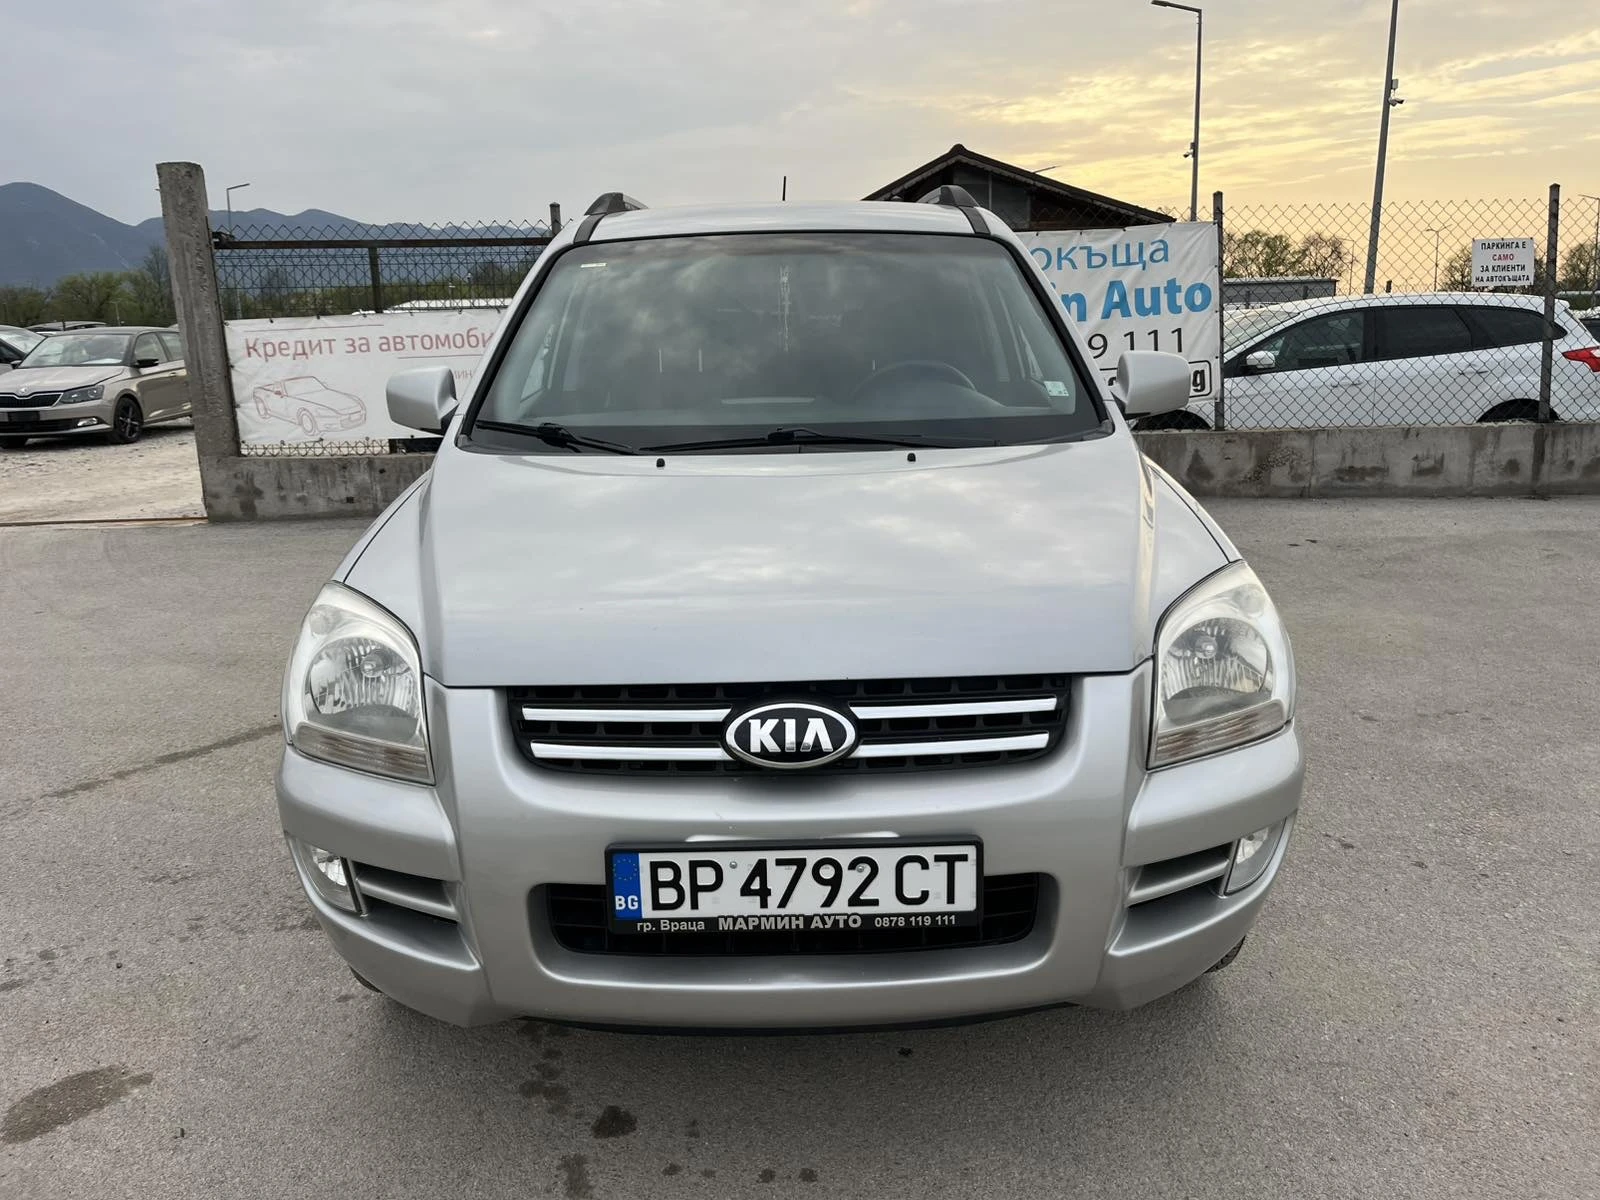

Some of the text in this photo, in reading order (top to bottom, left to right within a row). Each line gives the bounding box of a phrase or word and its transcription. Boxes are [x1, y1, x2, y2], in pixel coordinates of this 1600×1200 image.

[1481, 241, 1526, 250] ПАРКИНГА Е
[1492, 253, 1514, 261] САМО
[1480, 264, 1526, 273] ЗА КЛИЕНТИ
[1486, 274, 1530, 282] АВТОКЪЩАТА
[1101, 277, 1212, 320] Auto
[1123, 327, 1183, 353] 111
[244, 338, 336, 362] Кредит
[344, 337, 371, 353] за
[748, 718, 834, 753] KIA
[649, 854, 969, 911] BP 4792 CT
[614, 895, 639, 911] BG
[637, 915, 956, 932] гр. Враца МАРМИН АУТО 0878 119 111
